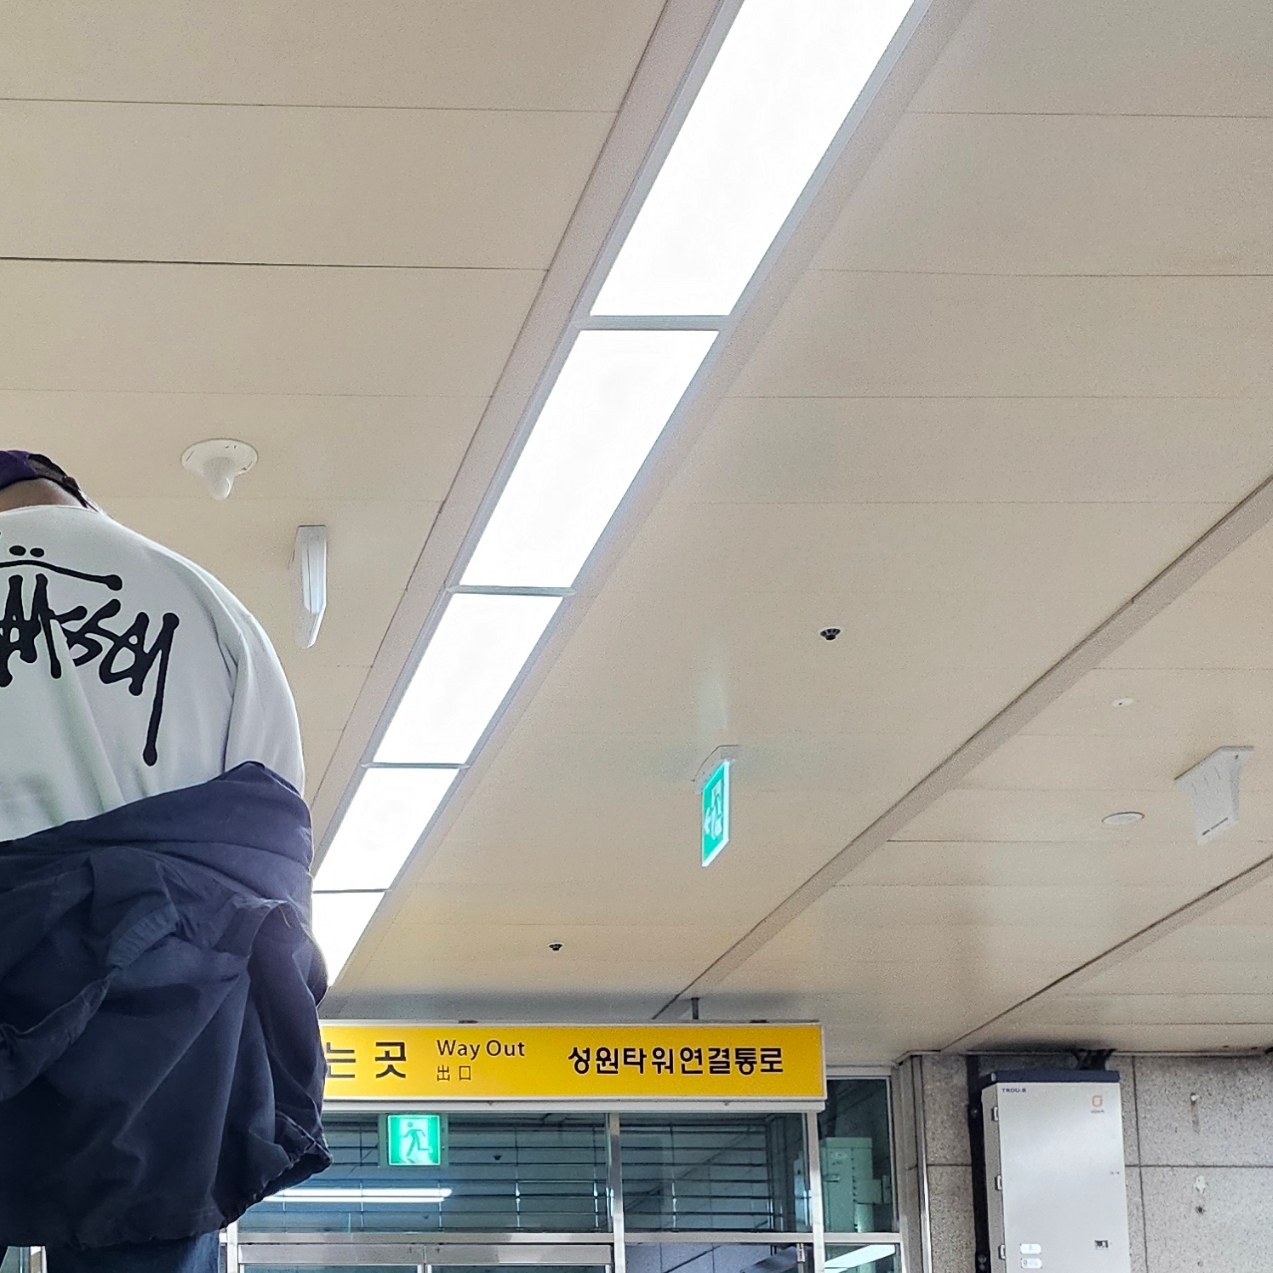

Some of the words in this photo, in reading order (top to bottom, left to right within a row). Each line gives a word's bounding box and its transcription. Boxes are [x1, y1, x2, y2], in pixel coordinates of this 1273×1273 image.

[375, 1041, 407, 1079] 곳
[436, 1039, 480, 1060] Way
[486, 1039, 525, 1057] Out
[568, 1046, 784, 1076] 성원타워연결통로
